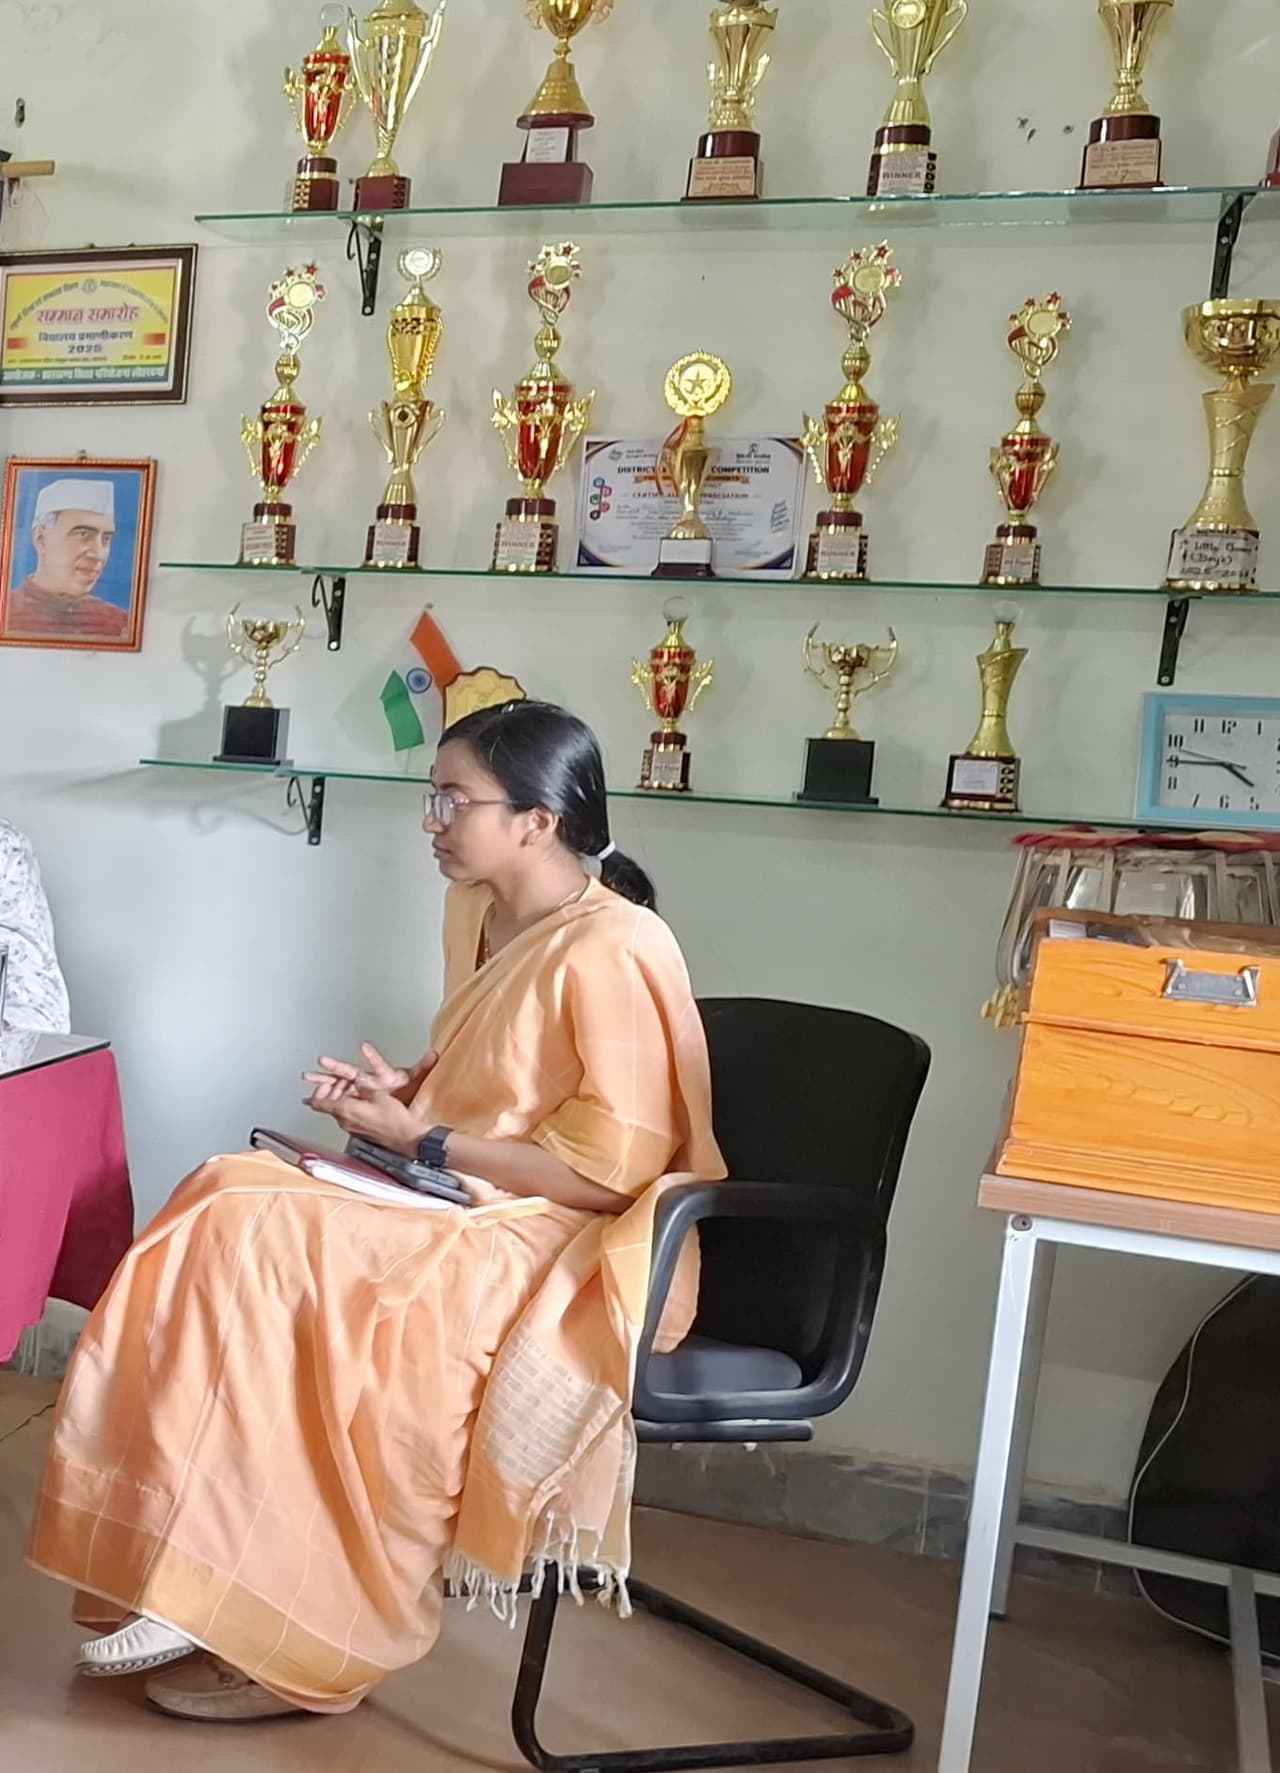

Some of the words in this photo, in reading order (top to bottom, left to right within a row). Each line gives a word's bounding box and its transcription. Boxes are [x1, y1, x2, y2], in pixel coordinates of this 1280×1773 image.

[711, 465, 769, 474] COMPETITION
[1221, 719, 1237, 734] 12
[1168, 733, 1184, 748] 10
[1219, 795, 1230, 808] 6
[1249, 796, 1260, 810] 5
